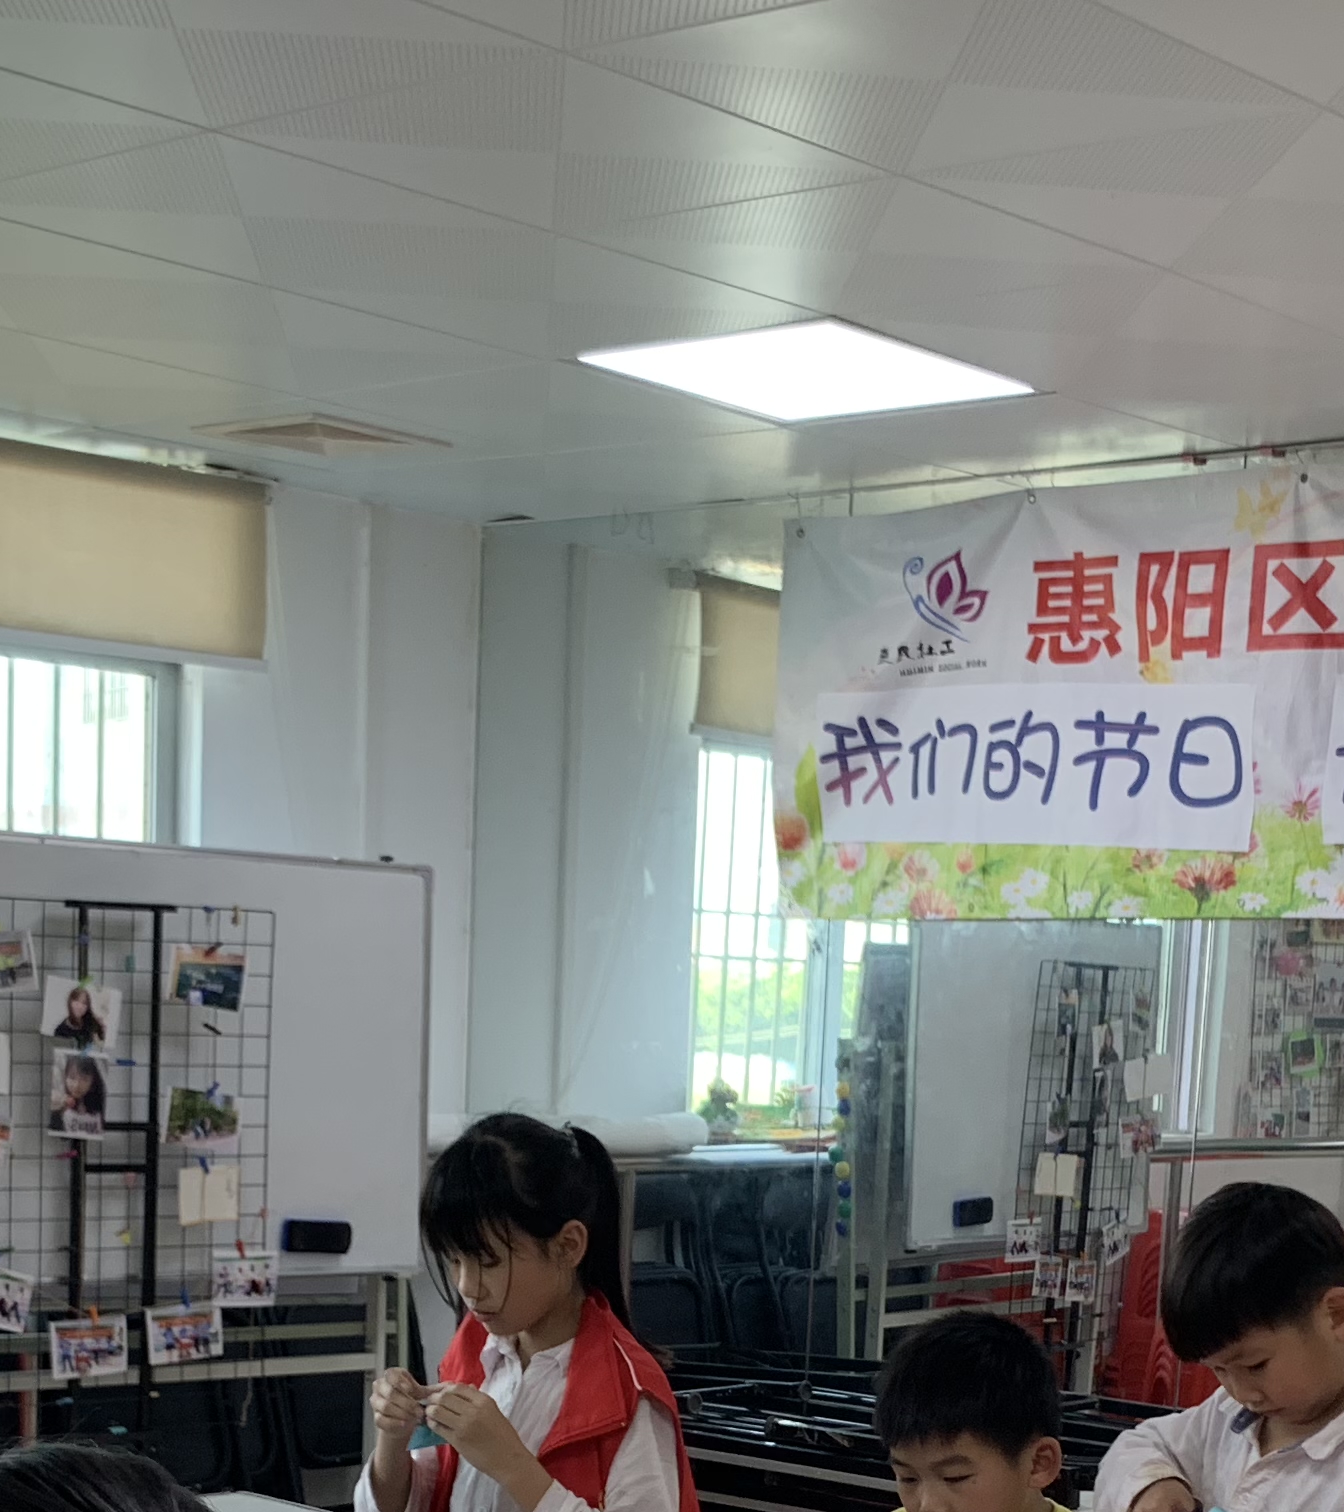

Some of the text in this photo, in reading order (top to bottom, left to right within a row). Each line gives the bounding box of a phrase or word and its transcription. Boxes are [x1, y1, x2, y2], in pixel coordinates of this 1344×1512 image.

[820, 709, 1243, 811] 我们的节日
